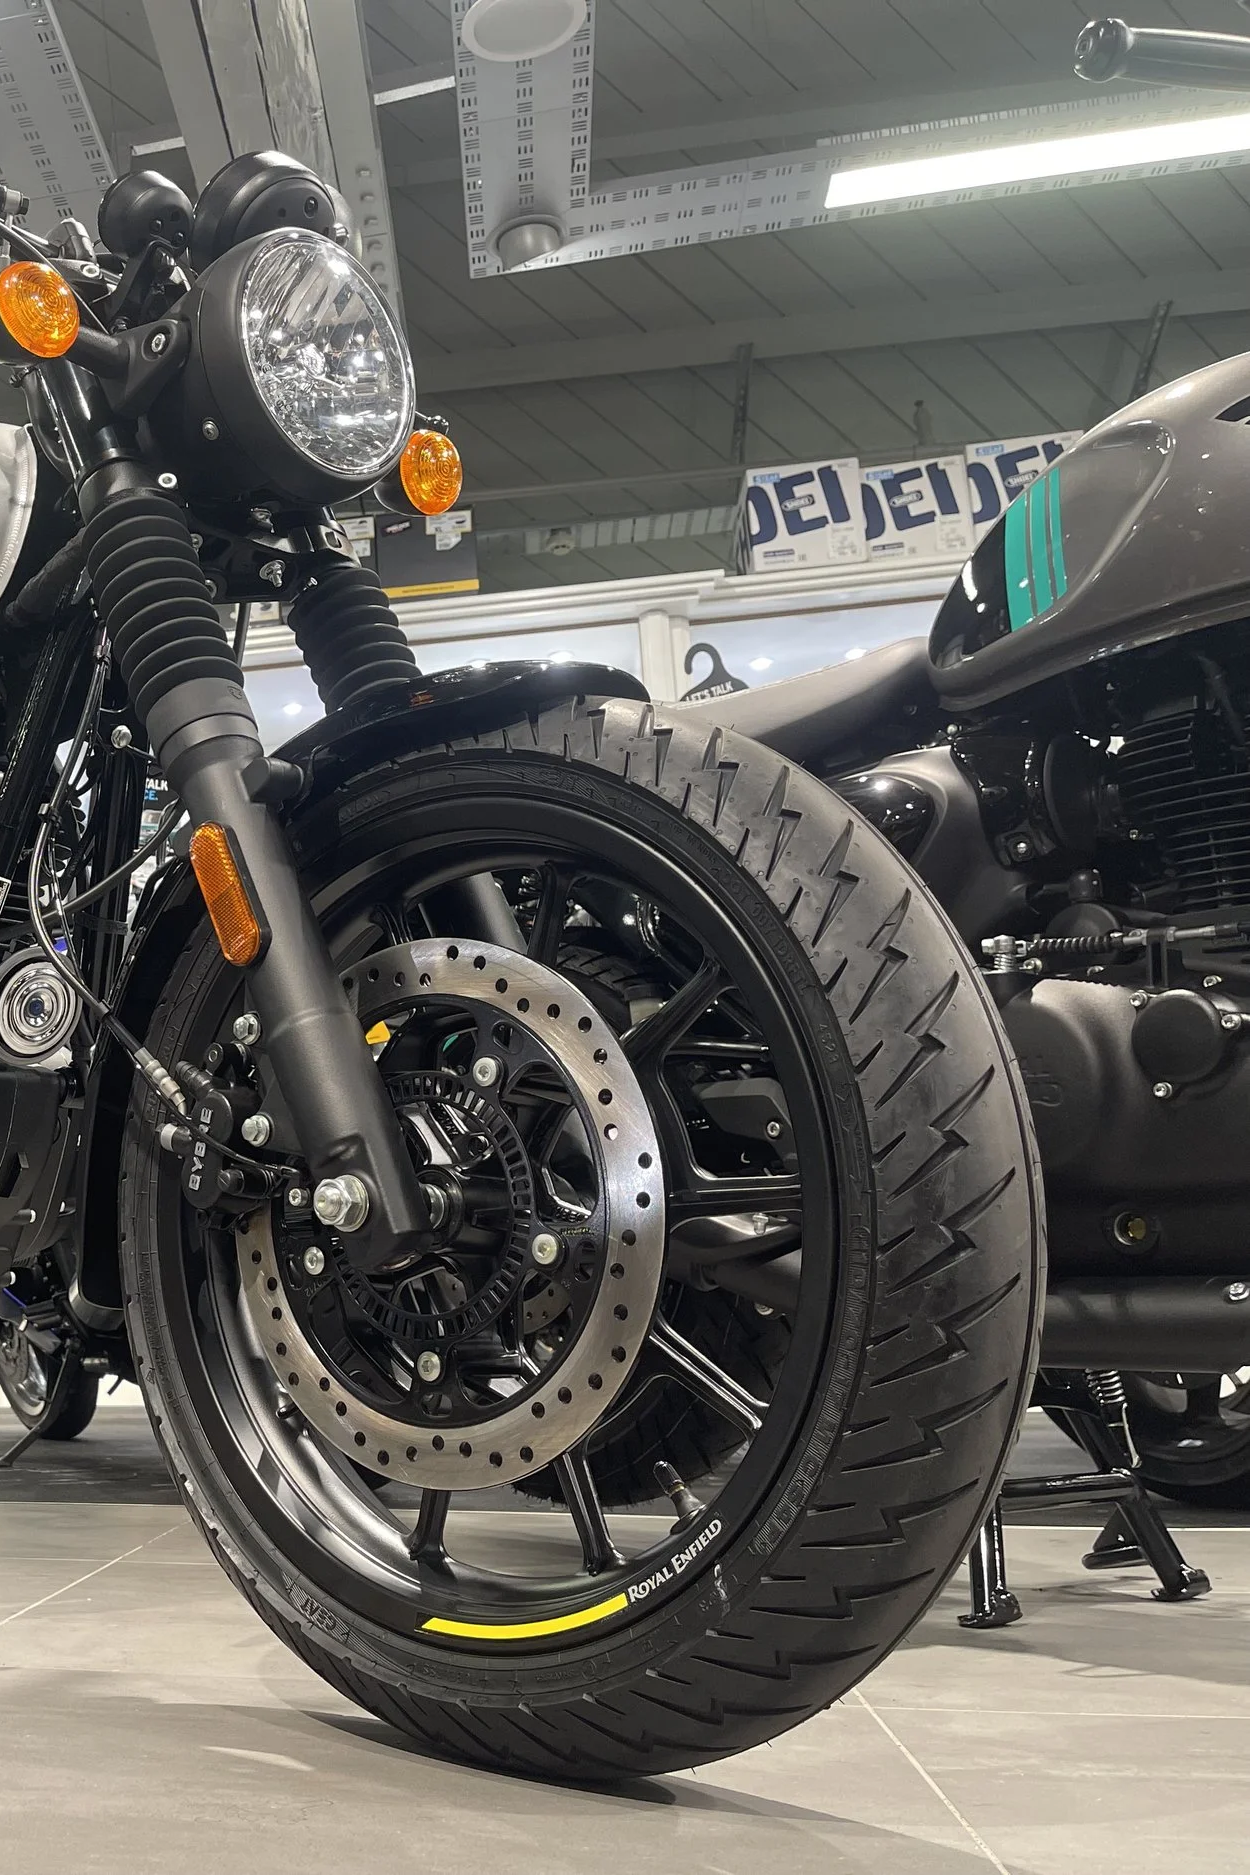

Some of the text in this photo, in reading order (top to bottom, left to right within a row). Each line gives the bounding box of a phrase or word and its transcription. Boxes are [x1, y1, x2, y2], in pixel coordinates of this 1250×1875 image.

[711, 681, 734, 697] TALK
[627, 1519, 722, 1602] ROYAL ENFIELD
